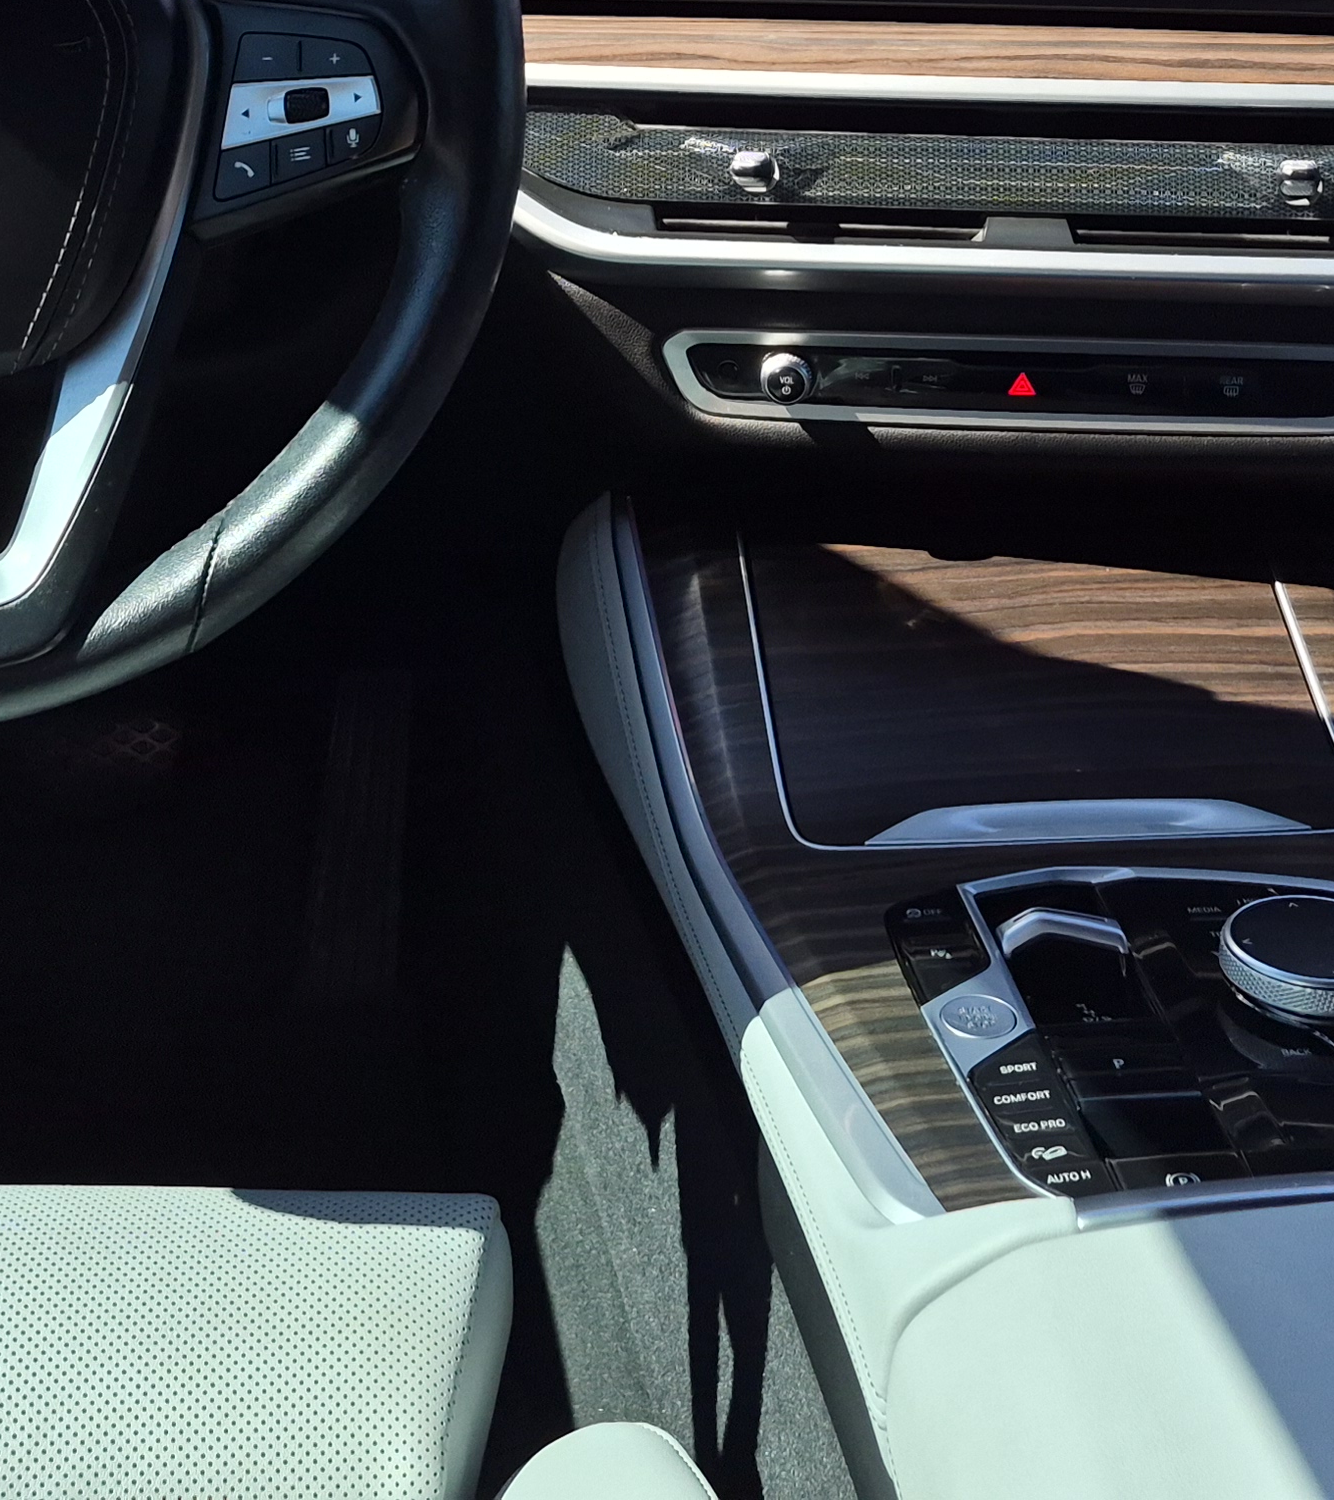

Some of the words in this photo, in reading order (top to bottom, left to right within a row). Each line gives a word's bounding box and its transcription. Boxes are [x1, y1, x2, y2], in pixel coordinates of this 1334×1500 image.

[779, 376, 795, 385] VOL
[1127, 374, 1148, 384] MAX
[1219, 376, 1244, 386] REAR
[923, 907, 943, 917] OFF
[1187, 905, 1222, 915] MEDIA
[1280, 1048, 1312, 1057] BACK
[999, 1061, 1038, 1076] SPORT
[1113, 1058, 1125, 1070] P
[993, 1089, 1051, 1106] COMFORT
[1013, 1120, 1040, 1134] ECO
[1040, 1117, 1066, 1130] PRO
[1046, 1171, 1080, 1185] AUTO
[1081, 1169, 1092, 1181] H
